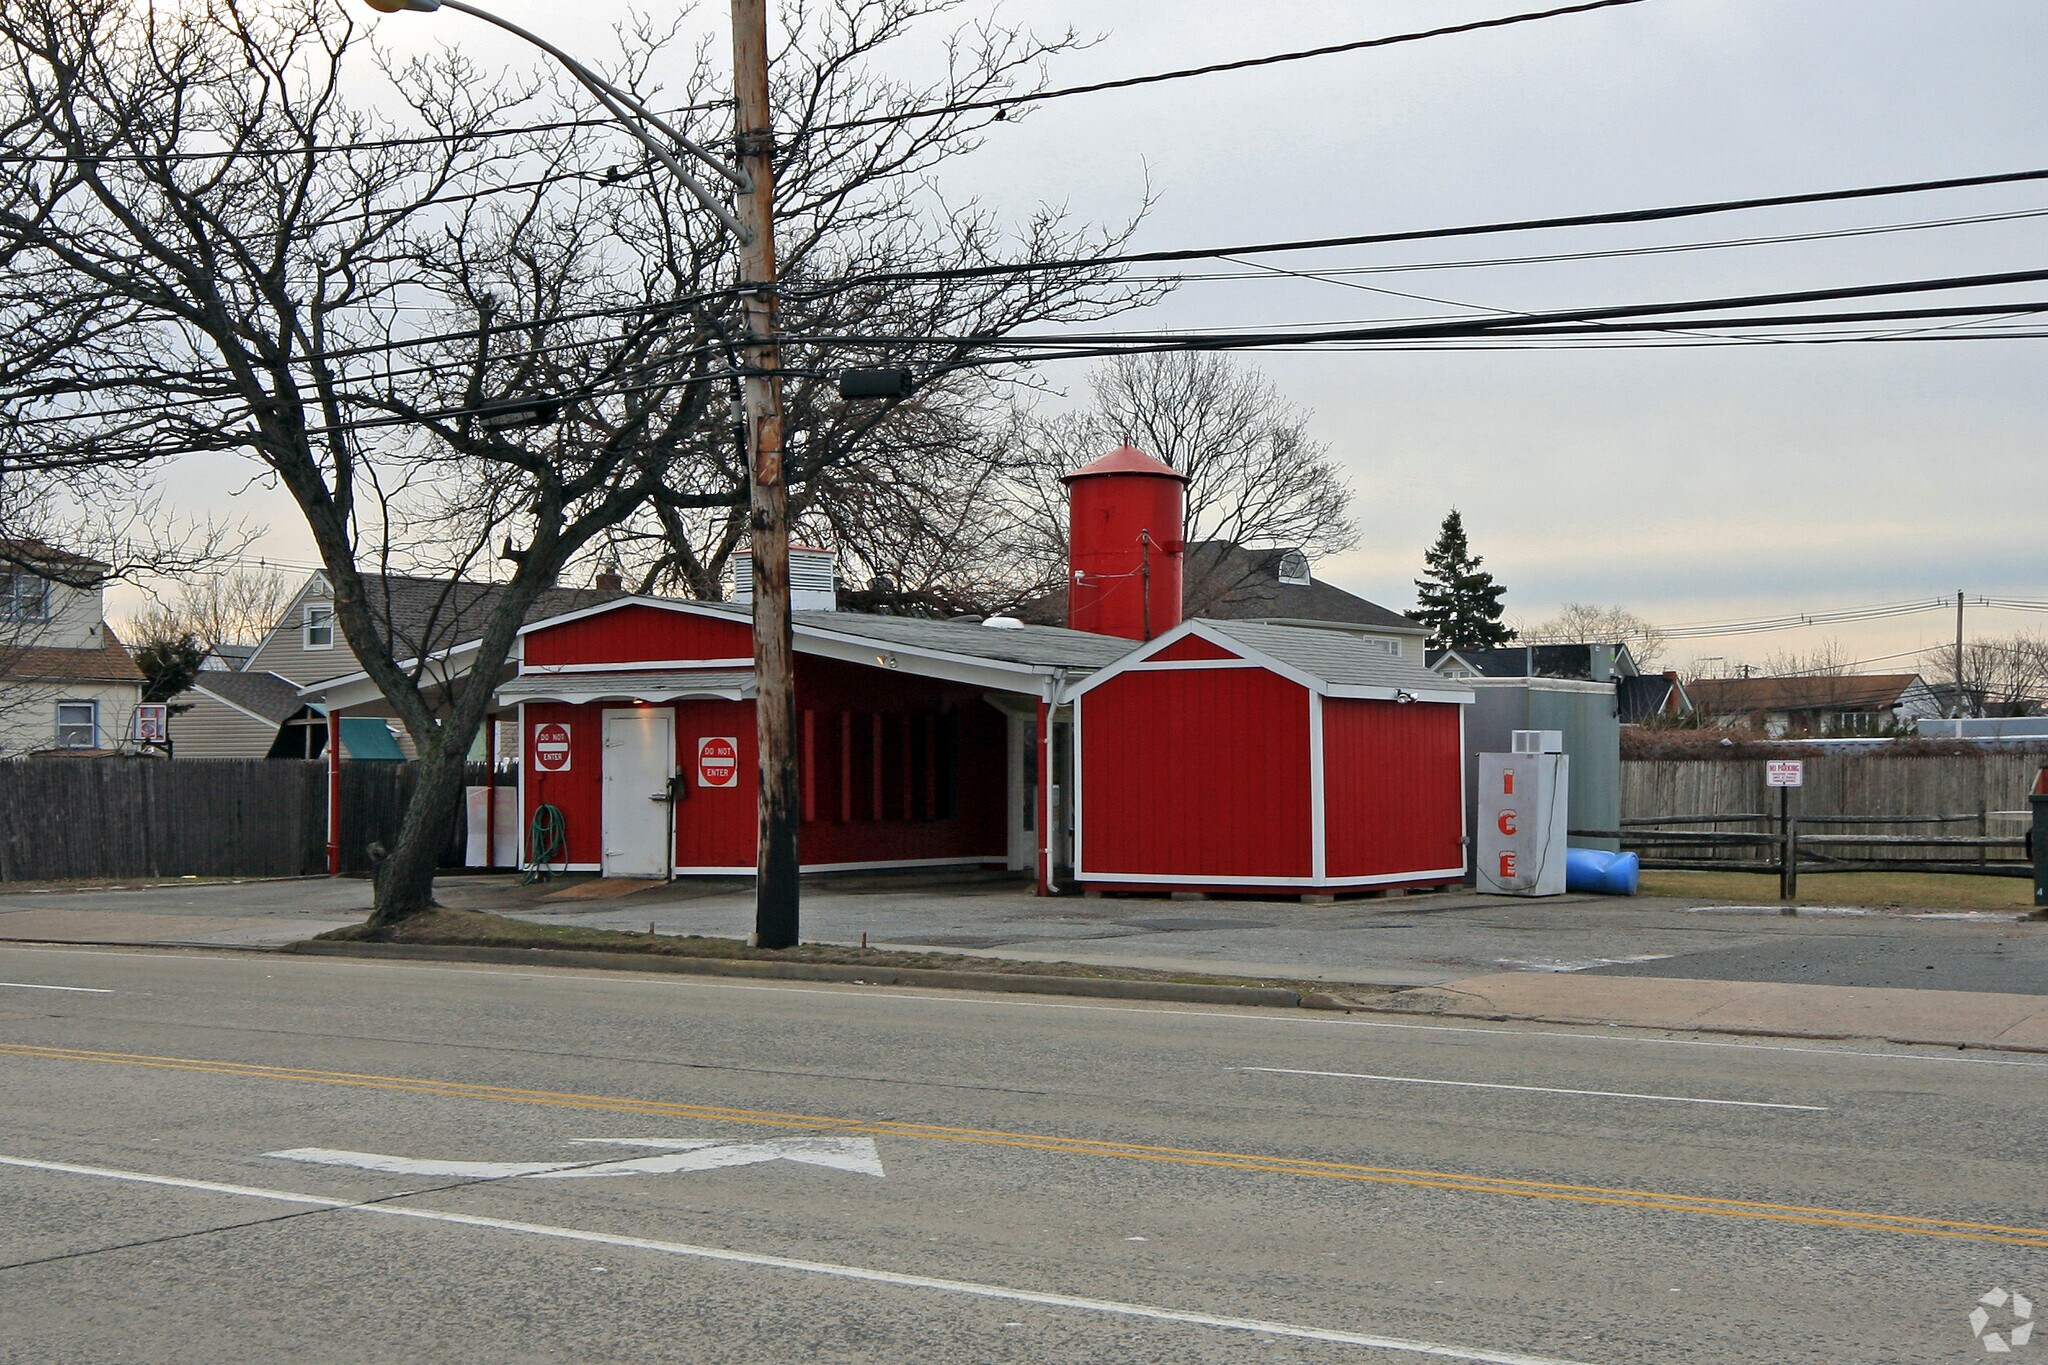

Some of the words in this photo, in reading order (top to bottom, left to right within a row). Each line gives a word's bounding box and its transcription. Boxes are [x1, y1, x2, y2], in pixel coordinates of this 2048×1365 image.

[540, 733, 549, 741] DO
[552, 733, 565, 741] NOT
[704, 747, 714, 755] DO
[717, 747, 731, 755] NOT
[707, 768, 728, 777] ENTER
[1497, 768, 1517, 878] ICE
